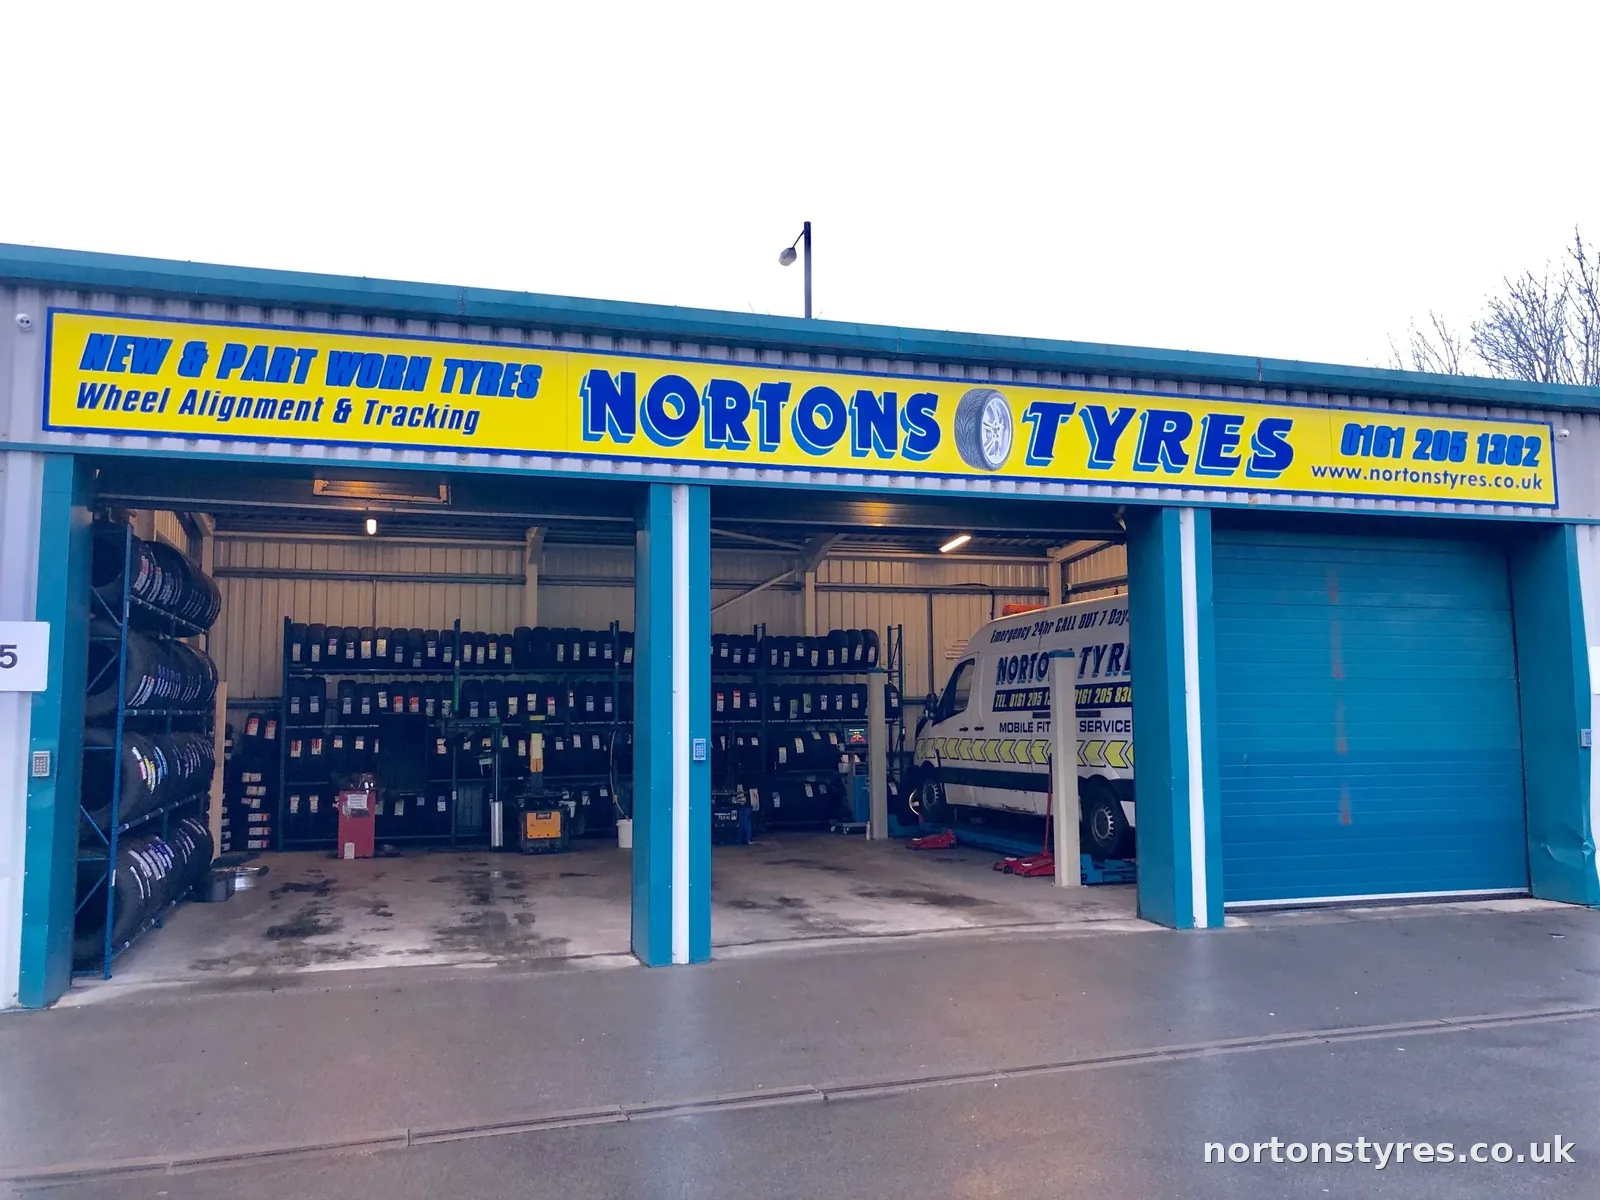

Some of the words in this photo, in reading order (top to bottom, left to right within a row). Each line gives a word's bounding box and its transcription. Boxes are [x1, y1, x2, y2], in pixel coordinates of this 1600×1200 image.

[79, 333, 173, 375] NEW
[177, 341, 209, 378] &
[216, 343, 318, 384] PART
[325, 350, 432, 392] WORN
[440, 358, 543, 399] TYRES
[76, 382, 171, 414] Wheel
[178, 389, 324, 422] Alignment
[332, 398, 352, 424] &
[363, 399, 480, 435] Tracking
[579, 369, 941, 462] NORTONS
[1022, 401, 1294, 479] TYRES
[1340, 423, 1405, 459] 0161
[1412, 428, 1469, 462] 205
[1477, 433, 1542, 467] 1362
[1311, 464, 1543, 490] www.nortonstyres.co.uk
[990, 625, 1032, 643] Emergency
[1032, 621, 1055, 637] 24hr
[1055, 615, 1077, 633] CALL
[1078, 610, 1100, 630] OUT
[1099, 610, 1107, 626] 7
[0, 644, 18, 669] 5
[996, 651, 1050, 686] NORTO
[1077, 643, 1131, 679] TYR
[995, 693, 1007, 708] TEL.
[1009, 692, 1026, 707] 0161
[1027, 690, 1043, 706] 205
[1093, 687, 1114, 705] 205
[999, 721, 1034, 733] MOBILE
[1080, 720, 1131, 734] SERVICE
